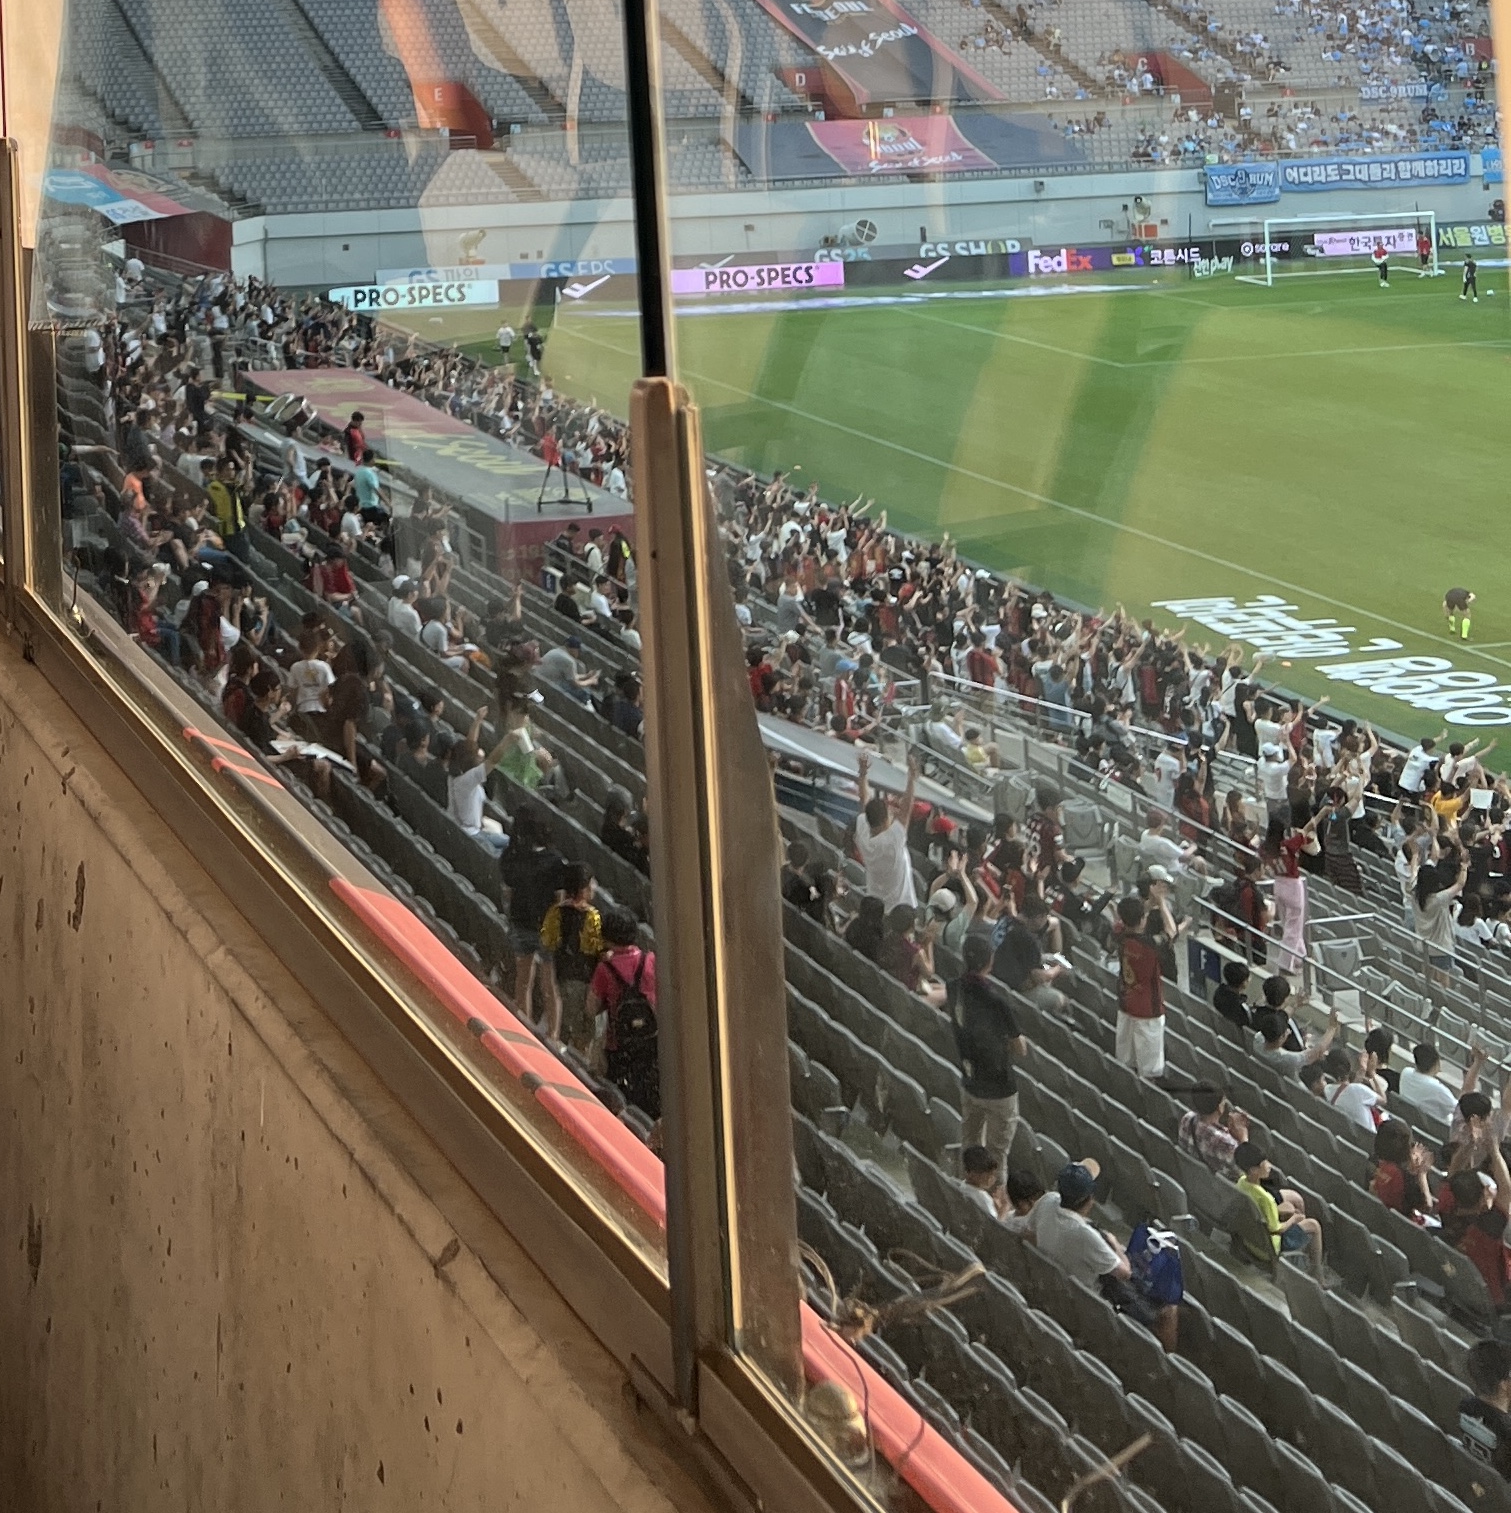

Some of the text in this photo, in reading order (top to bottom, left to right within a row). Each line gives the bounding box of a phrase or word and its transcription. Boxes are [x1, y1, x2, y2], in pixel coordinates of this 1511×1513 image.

[795, 73, 806, 86] D
[434, 88, 444, 101] E
[1286, 163, 1340, 184] 어디라도
[1028, 248, 1093, 274] FedEx
[704, 265, 814, 290] PRO-SPECS
[354, 283, 467, 308] PRO-SPECS
